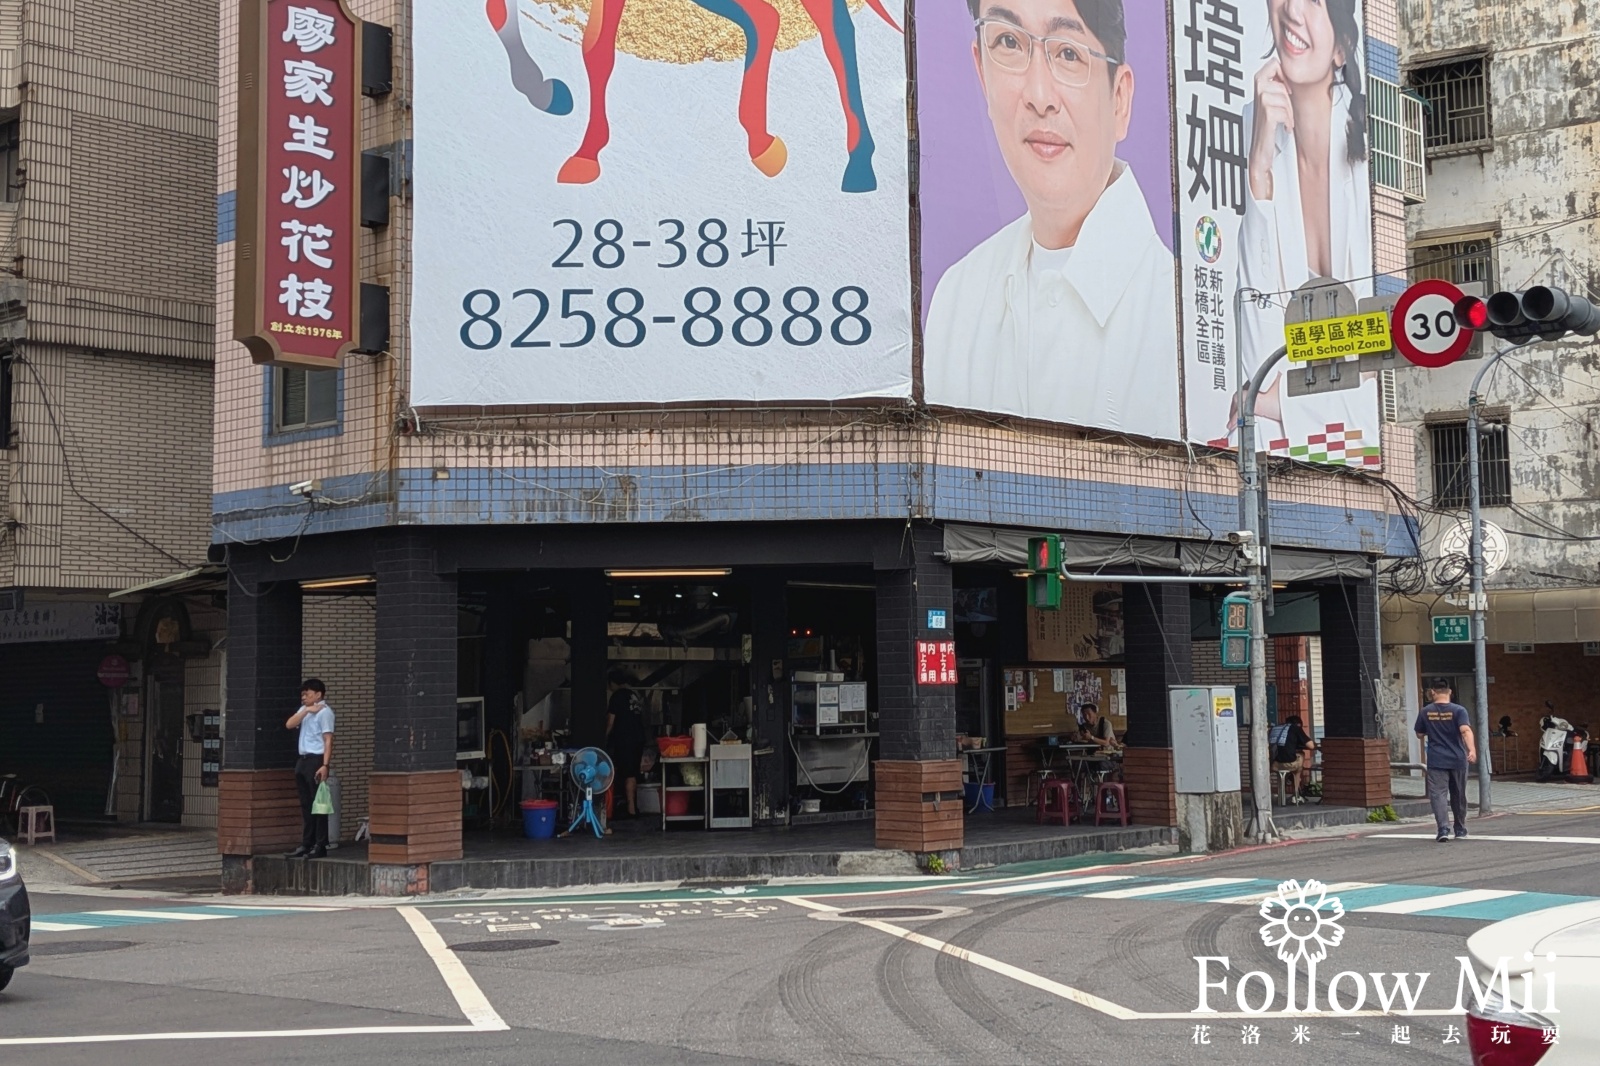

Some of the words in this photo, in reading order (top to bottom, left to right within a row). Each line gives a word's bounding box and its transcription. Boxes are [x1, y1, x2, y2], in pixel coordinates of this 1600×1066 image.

[1184, 0, 1247, 216] 瑋姍
[278, 5, 336, 321] 廖家生炒花枝
[270, 321, 343, 340] 創立於1976年
[459, 285, 873, 350] 8258-8888
[1194, 264, 1210, 364] 板橋全區
[1209, 268, 1227, 391] 新北市議員
[1289, 317, 1385, 347] 通學區終點
[1411, 310, 1456, 341] 30
[1292, 347, 1313, 358] End
[1316, 341, 1354, 355] School
[1358, 338, 1386, 350] Zone
